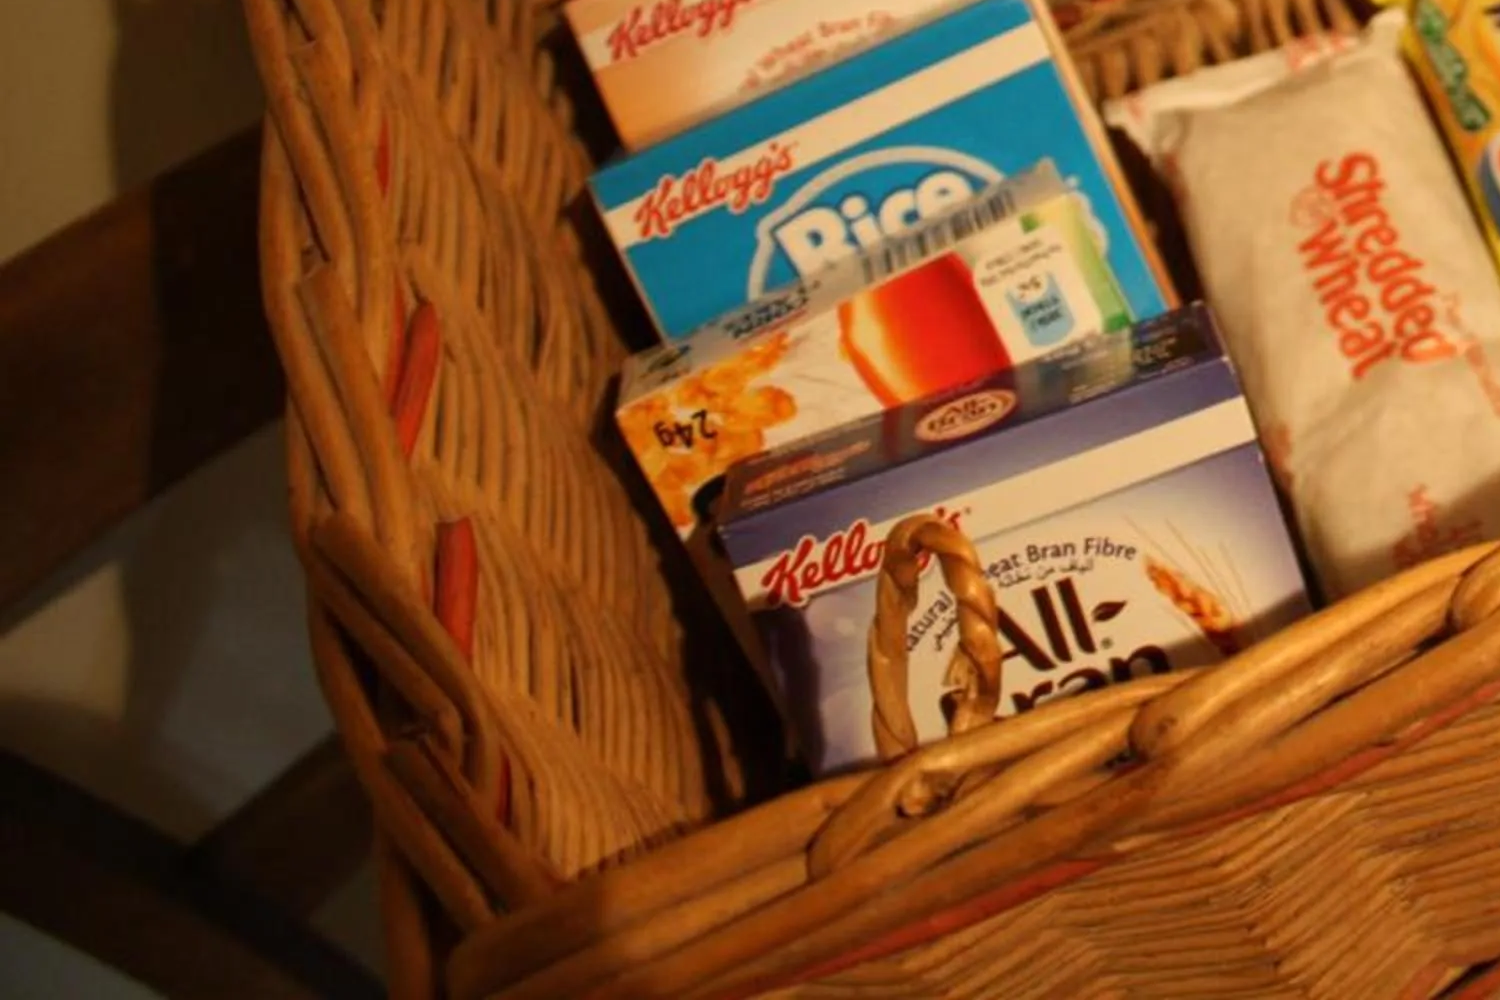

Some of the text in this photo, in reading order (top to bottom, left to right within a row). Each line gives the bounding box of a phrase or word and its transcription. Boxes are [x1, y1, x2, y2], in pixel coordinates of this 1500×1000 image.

[633, 141, 794, 238] Kellogg's
[772, 170, 974, 280] Rice
[1296, 218, 1397, 381] Wheat
[1313, 151, 1460, 366] Shredded
[652, 408, 718, 448] 24g
[761, 506, 963, 605] Kello's
[906, 590, 953, 652] atural
[1025, 541, 1077, 564] Bran
[1084, 536, 1137, 562] Fibre
